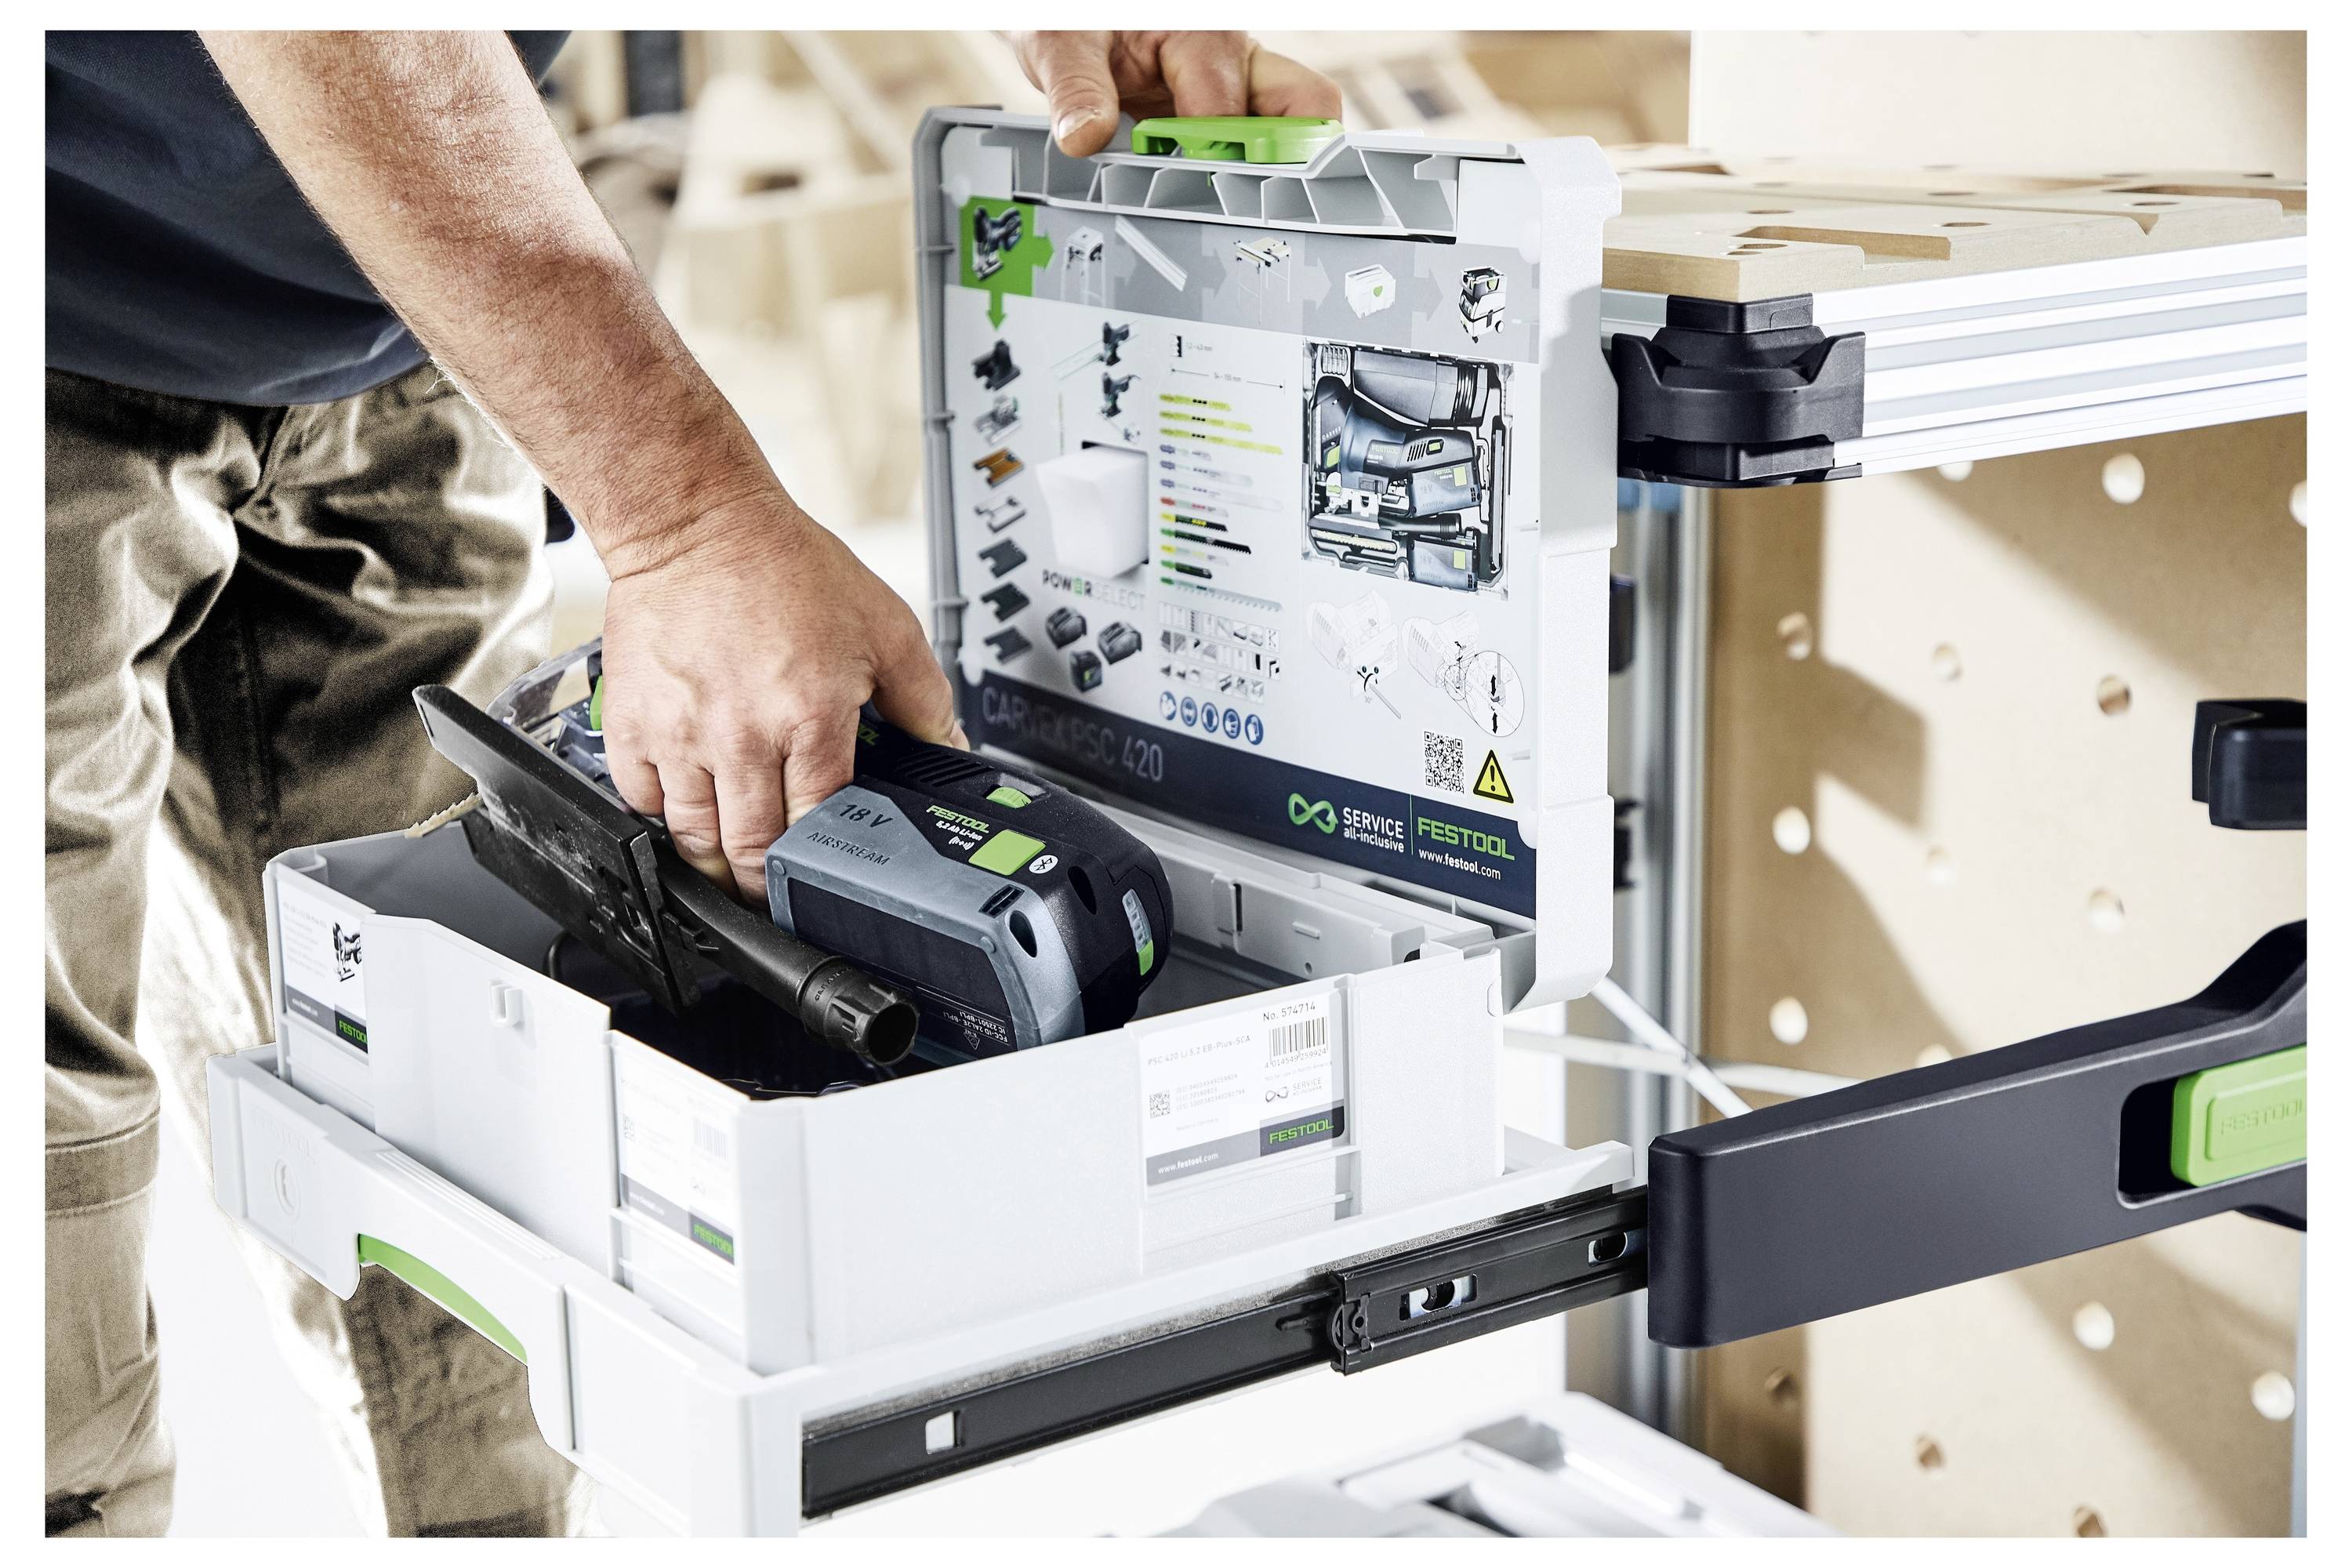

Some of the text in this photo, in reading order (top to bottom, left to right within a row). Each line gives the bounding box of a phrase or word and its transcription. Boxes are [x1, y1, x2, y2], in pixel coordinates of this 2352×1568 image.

[1123, 735, 1163, 782] 420
[839, 804, 894, 828] 18 V
[926, 804, 989, 833] FESTOOL
[1342, 807, 1404, 840] SERVICE
[807, 832, 891, 866] AIRSTREAM
[1343, 826, 1404, 853] all-inclusive
[1417, 816, 1515, 861] FESTOOL
[1419, 848, 1501, 880] www.festool.com
[1263, 1002, 1316, 1022] No. 574714
[1269, 1118, 1334, 1145] FESTOOL
[1158, 1152, 1219, 1174] www.festool.com
